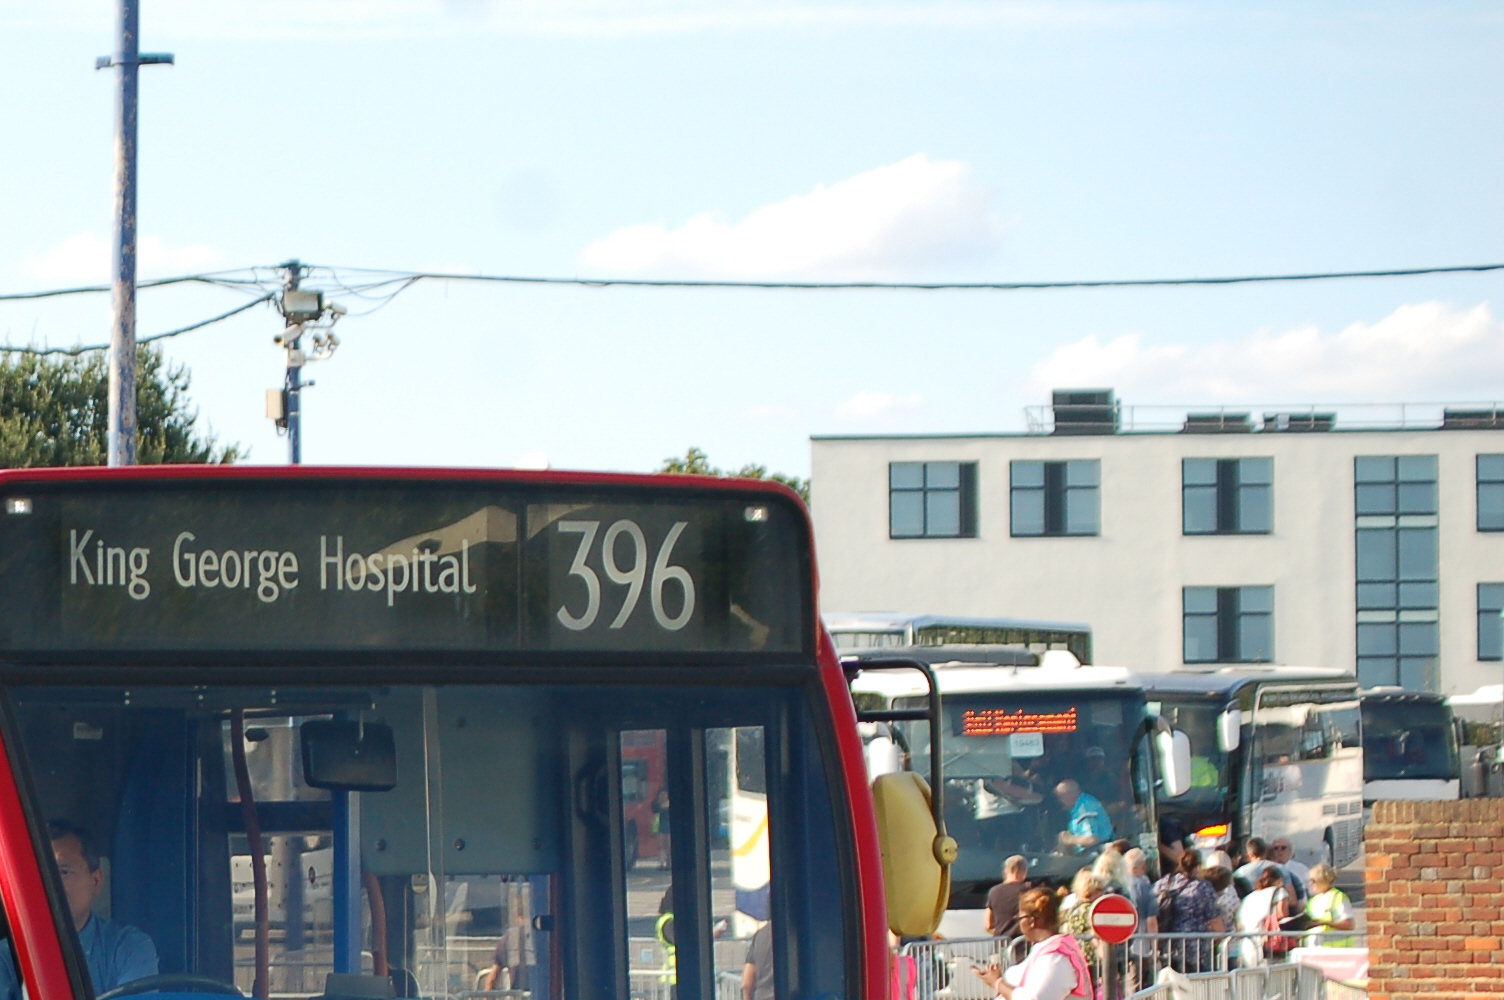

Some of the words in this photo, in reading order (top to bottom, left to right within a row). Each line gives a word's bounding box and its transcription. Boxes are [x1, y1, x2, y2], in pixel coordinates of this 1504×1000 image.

[69, 529, 151, 601] King
[172, 531, 299, 603] George
[319, 535, 477, 606] Hospital
[556, 519, 696, 632] 396
